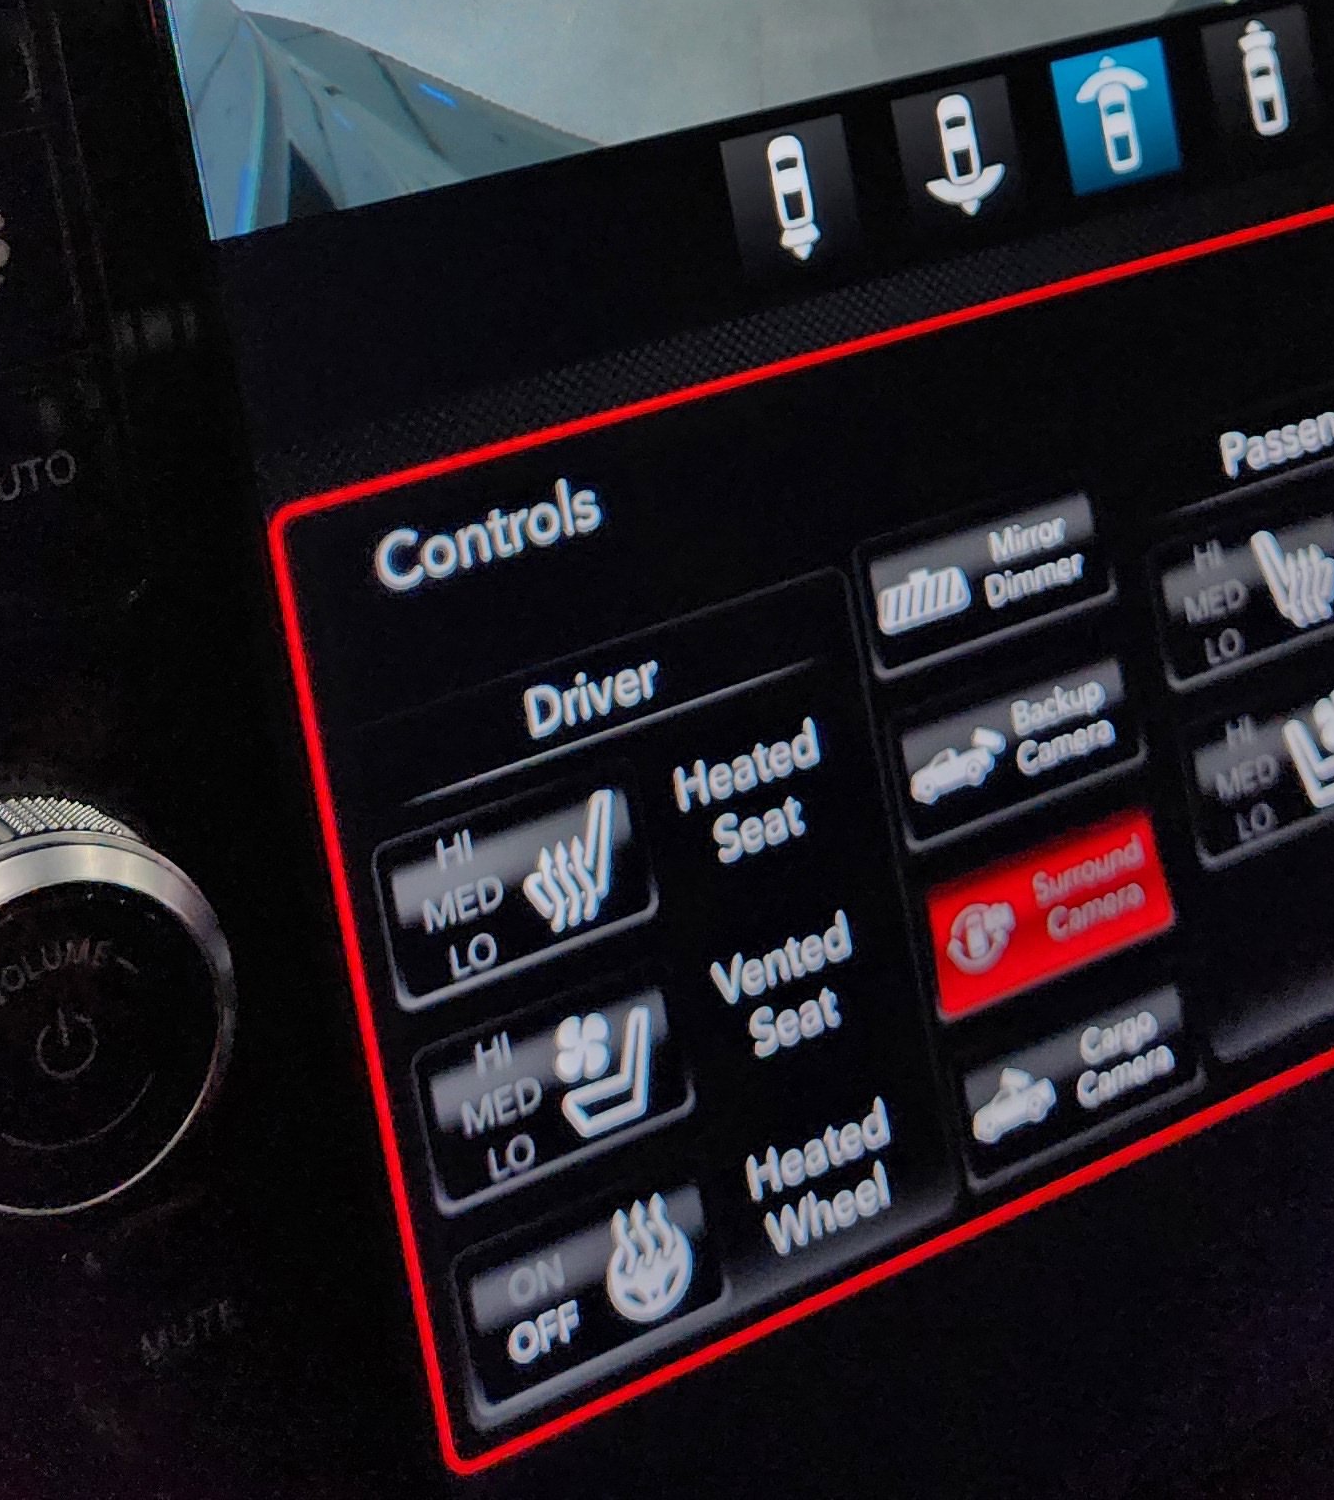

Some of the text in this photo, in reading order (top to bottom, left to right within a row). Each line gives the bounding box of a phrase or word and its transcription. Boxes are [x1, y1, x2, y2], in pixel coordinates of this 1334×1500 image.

[374, 477, 603, 591] Controls
[988, 517, 1066, 564] Mirror
[1193, 539, 1225, 574] HI
[984, 552, 1085, 610] Dimmer
[1183, 578, 1248, 625] MED
[1204, 626, 1246, 667] LO
[523, 659, 660, 740] Driver
[1011, 681, 1106, 737] Backup
[1017, 719, 1116, 777] Camera
[1224, 713, 1259, 748] HI
[672, 715, 822, 814] Heated
[1214, 754, 1280, 801] MED
[435, 827, 475, 872] HI
[712, 796, 808, 865] Seat
[1234, 802, 1279, 843] LO
[1032, 832, 1145, 909] Surround
[422, 875, 505, 936] MED
[1046, 882, 1146, 943] Camera
[448, 931, 498, 980] LO
[710, 908, 855, 1006] Vented
[748, 986, 844, 1059] Seat
[1080, 1010, 1159, 1066] Cargo
[474, 1030, 513, 1078] HI
[1076, 1044, 1177, 1110] Camera
[464, 1076, 543, 1140] MED
[487, 1132, 537, 1183] LO
[745, 1096, 893, 1203] Heated
[765, 1159, 893, 1257] Wheel
[507, 1253, 567, 1302] ON
[138, 1298, 240, 1368] MUTE
[507, 1299, 582, 1366] OFF
